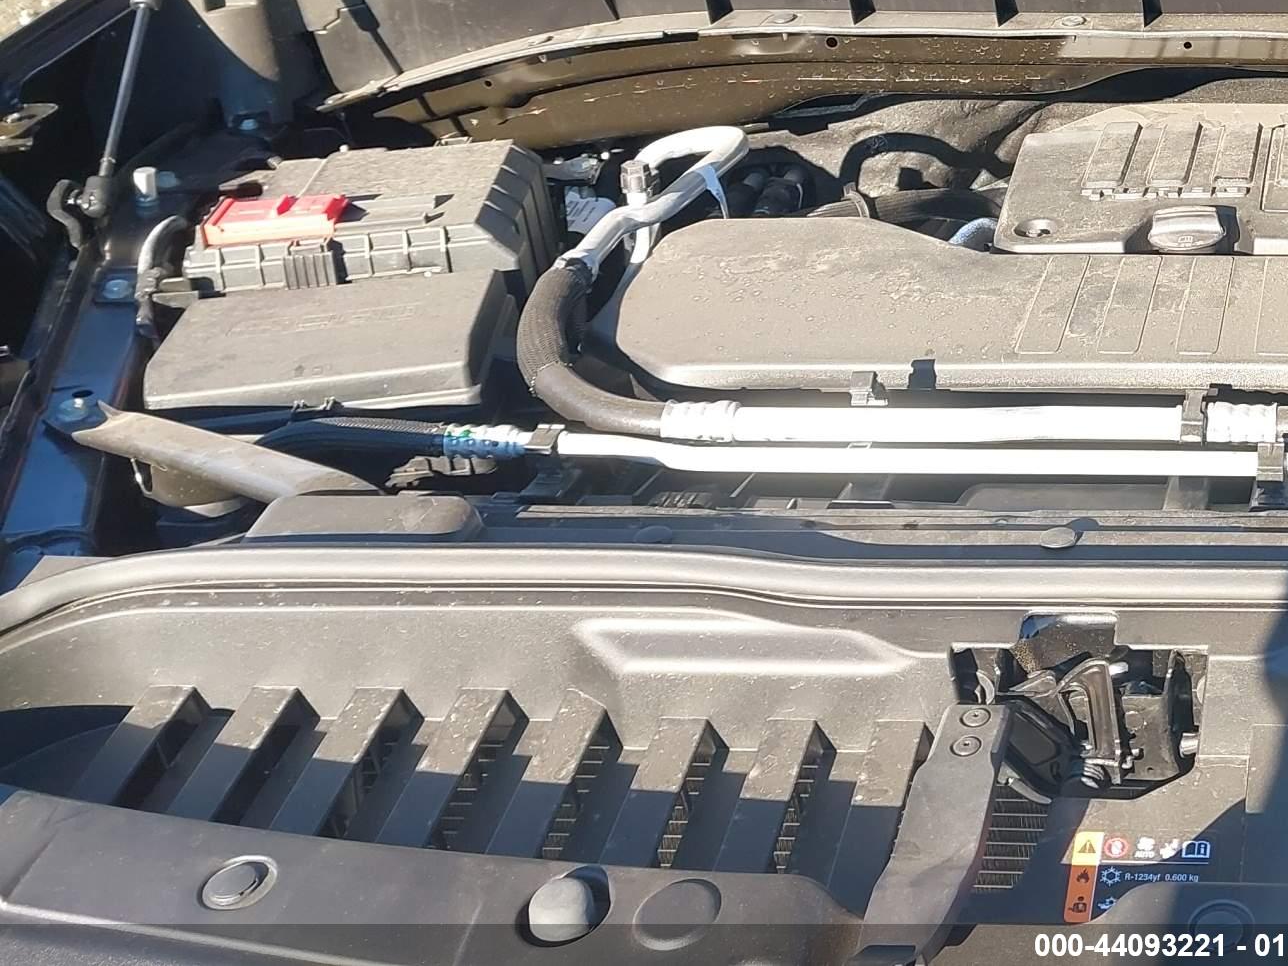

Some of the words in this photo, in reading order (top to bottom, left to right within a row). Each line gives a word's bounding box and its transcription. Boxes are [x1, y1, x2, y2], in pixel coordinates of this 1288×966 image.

[1124, 873, 1161, 882] R-1234yf
[1164, 873, 1187, 881] 0.600
[1188, 873, 1199, 883] kg
